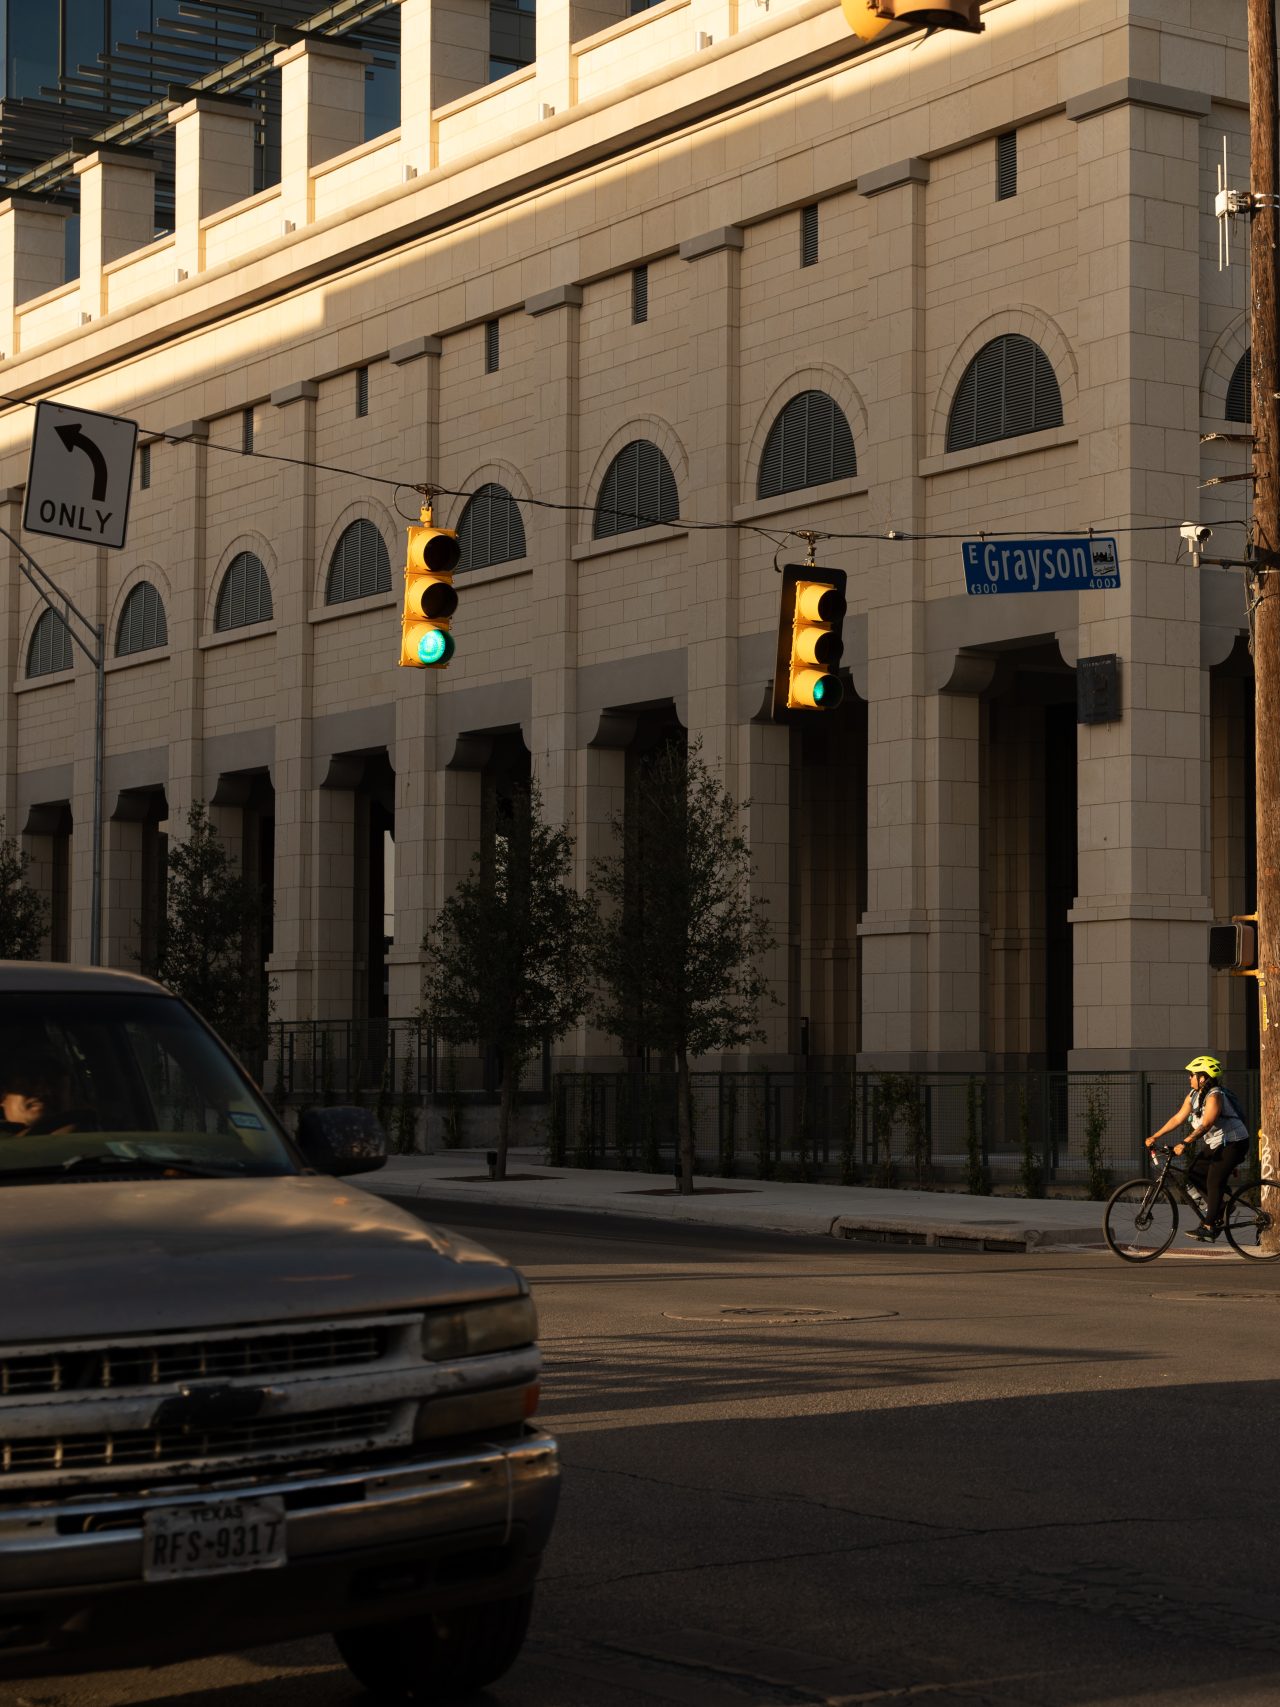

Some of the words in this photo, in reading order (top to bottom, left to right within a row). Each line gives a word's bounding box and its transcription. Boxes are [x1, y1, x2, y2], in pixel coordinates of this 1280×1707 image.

[39, 499, 113, 534] ONLY
[968, 544, 979, 564] E
[983, 543, 1088, 591] Grayson
[976, 583, 998, 594] 300
[1089, 577, 1111, 589] 400
[191, 1504, 244, 1523] TEXAS
